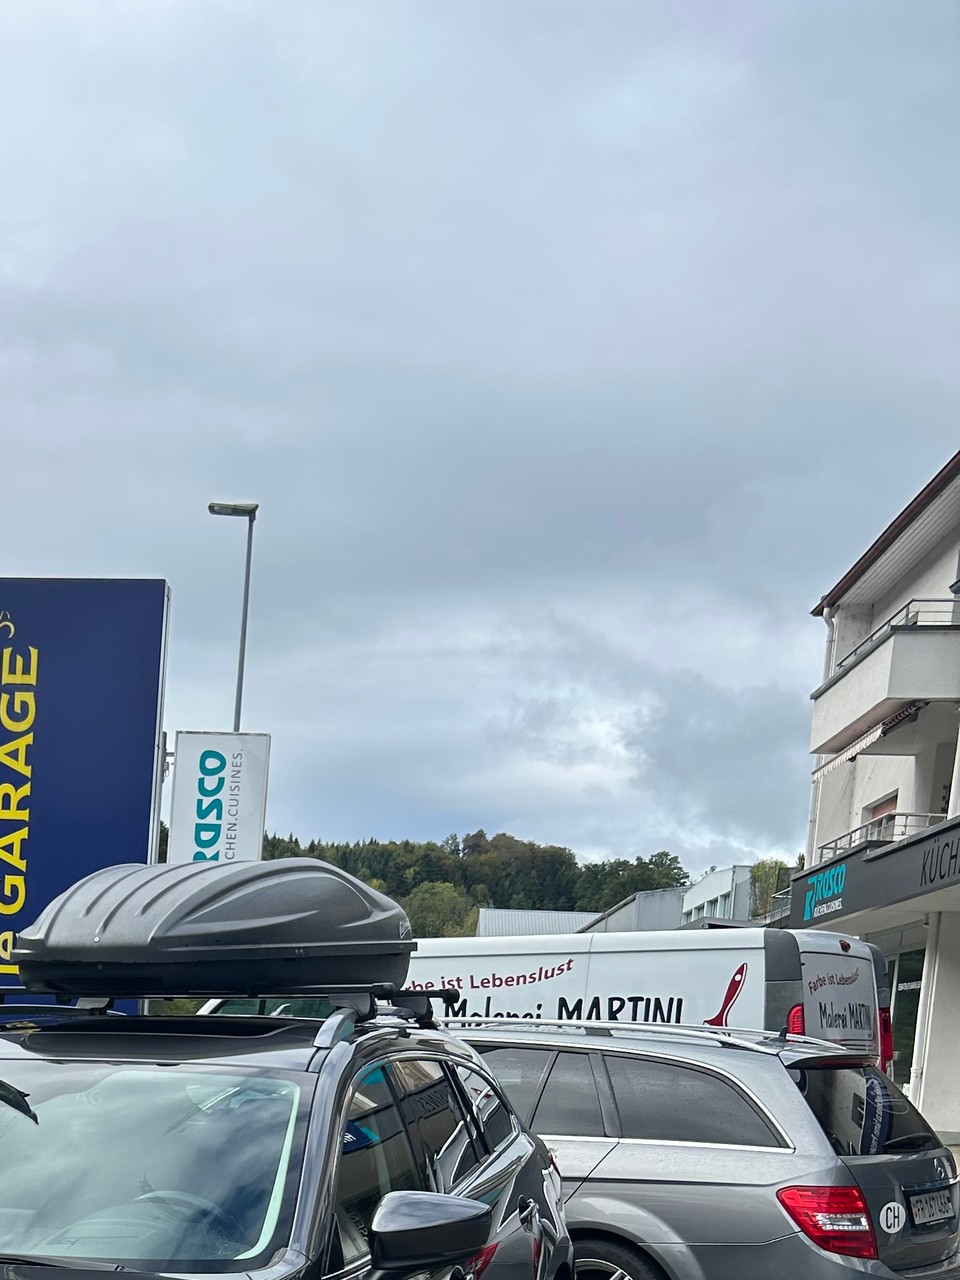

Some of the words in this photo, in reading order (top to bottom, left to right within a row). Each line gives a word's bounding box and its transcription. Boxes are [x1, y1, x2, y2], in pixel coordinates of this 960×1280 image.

[440, 976, 463, 990] ist
[470, 958, 575, 989] Lebenslust
[808, 974, 827, 995] Farbe
[558, 996, 684, 1028] MARTINI
[885, 1206, 900, 1230] CH
